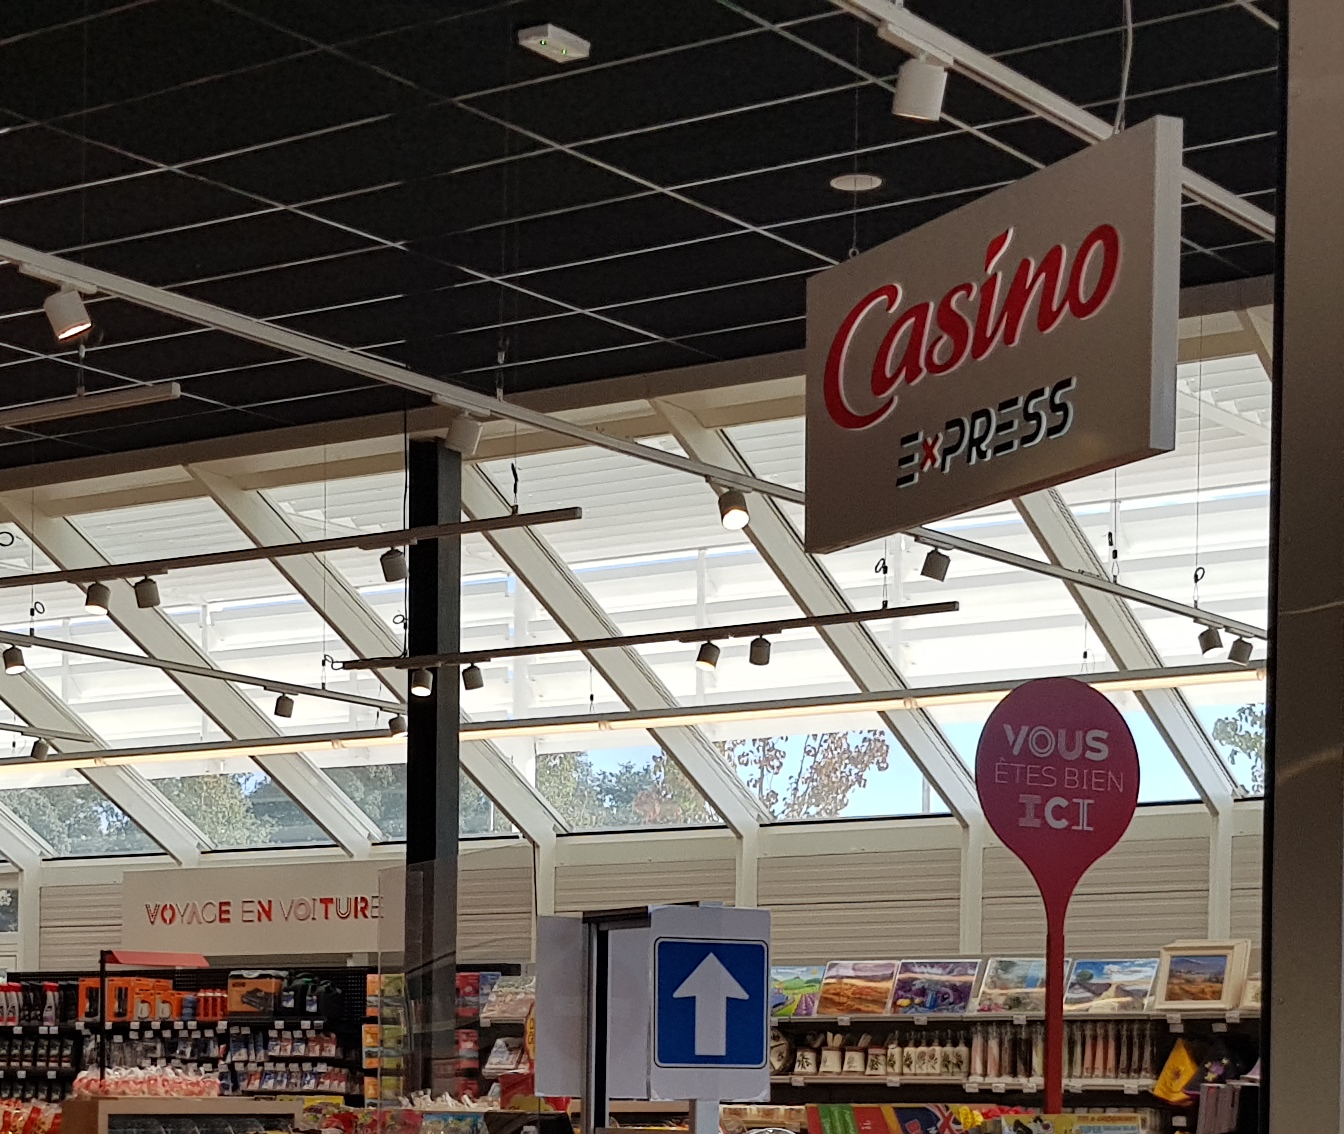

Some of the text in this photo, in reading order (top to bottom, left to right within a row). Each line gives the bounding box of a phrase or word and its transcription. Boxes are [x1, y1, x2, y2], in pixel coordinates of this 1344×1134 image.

[823, 223, 1122, 430] Casino
[1003, 723, 1109, 761] VOUS
[994, 757, 1124, 792] ÊTES BIEN
[1018, 794, 1095, 831] ICI
[145, 895, 385, 926] VOYAGE EN VOITURE
